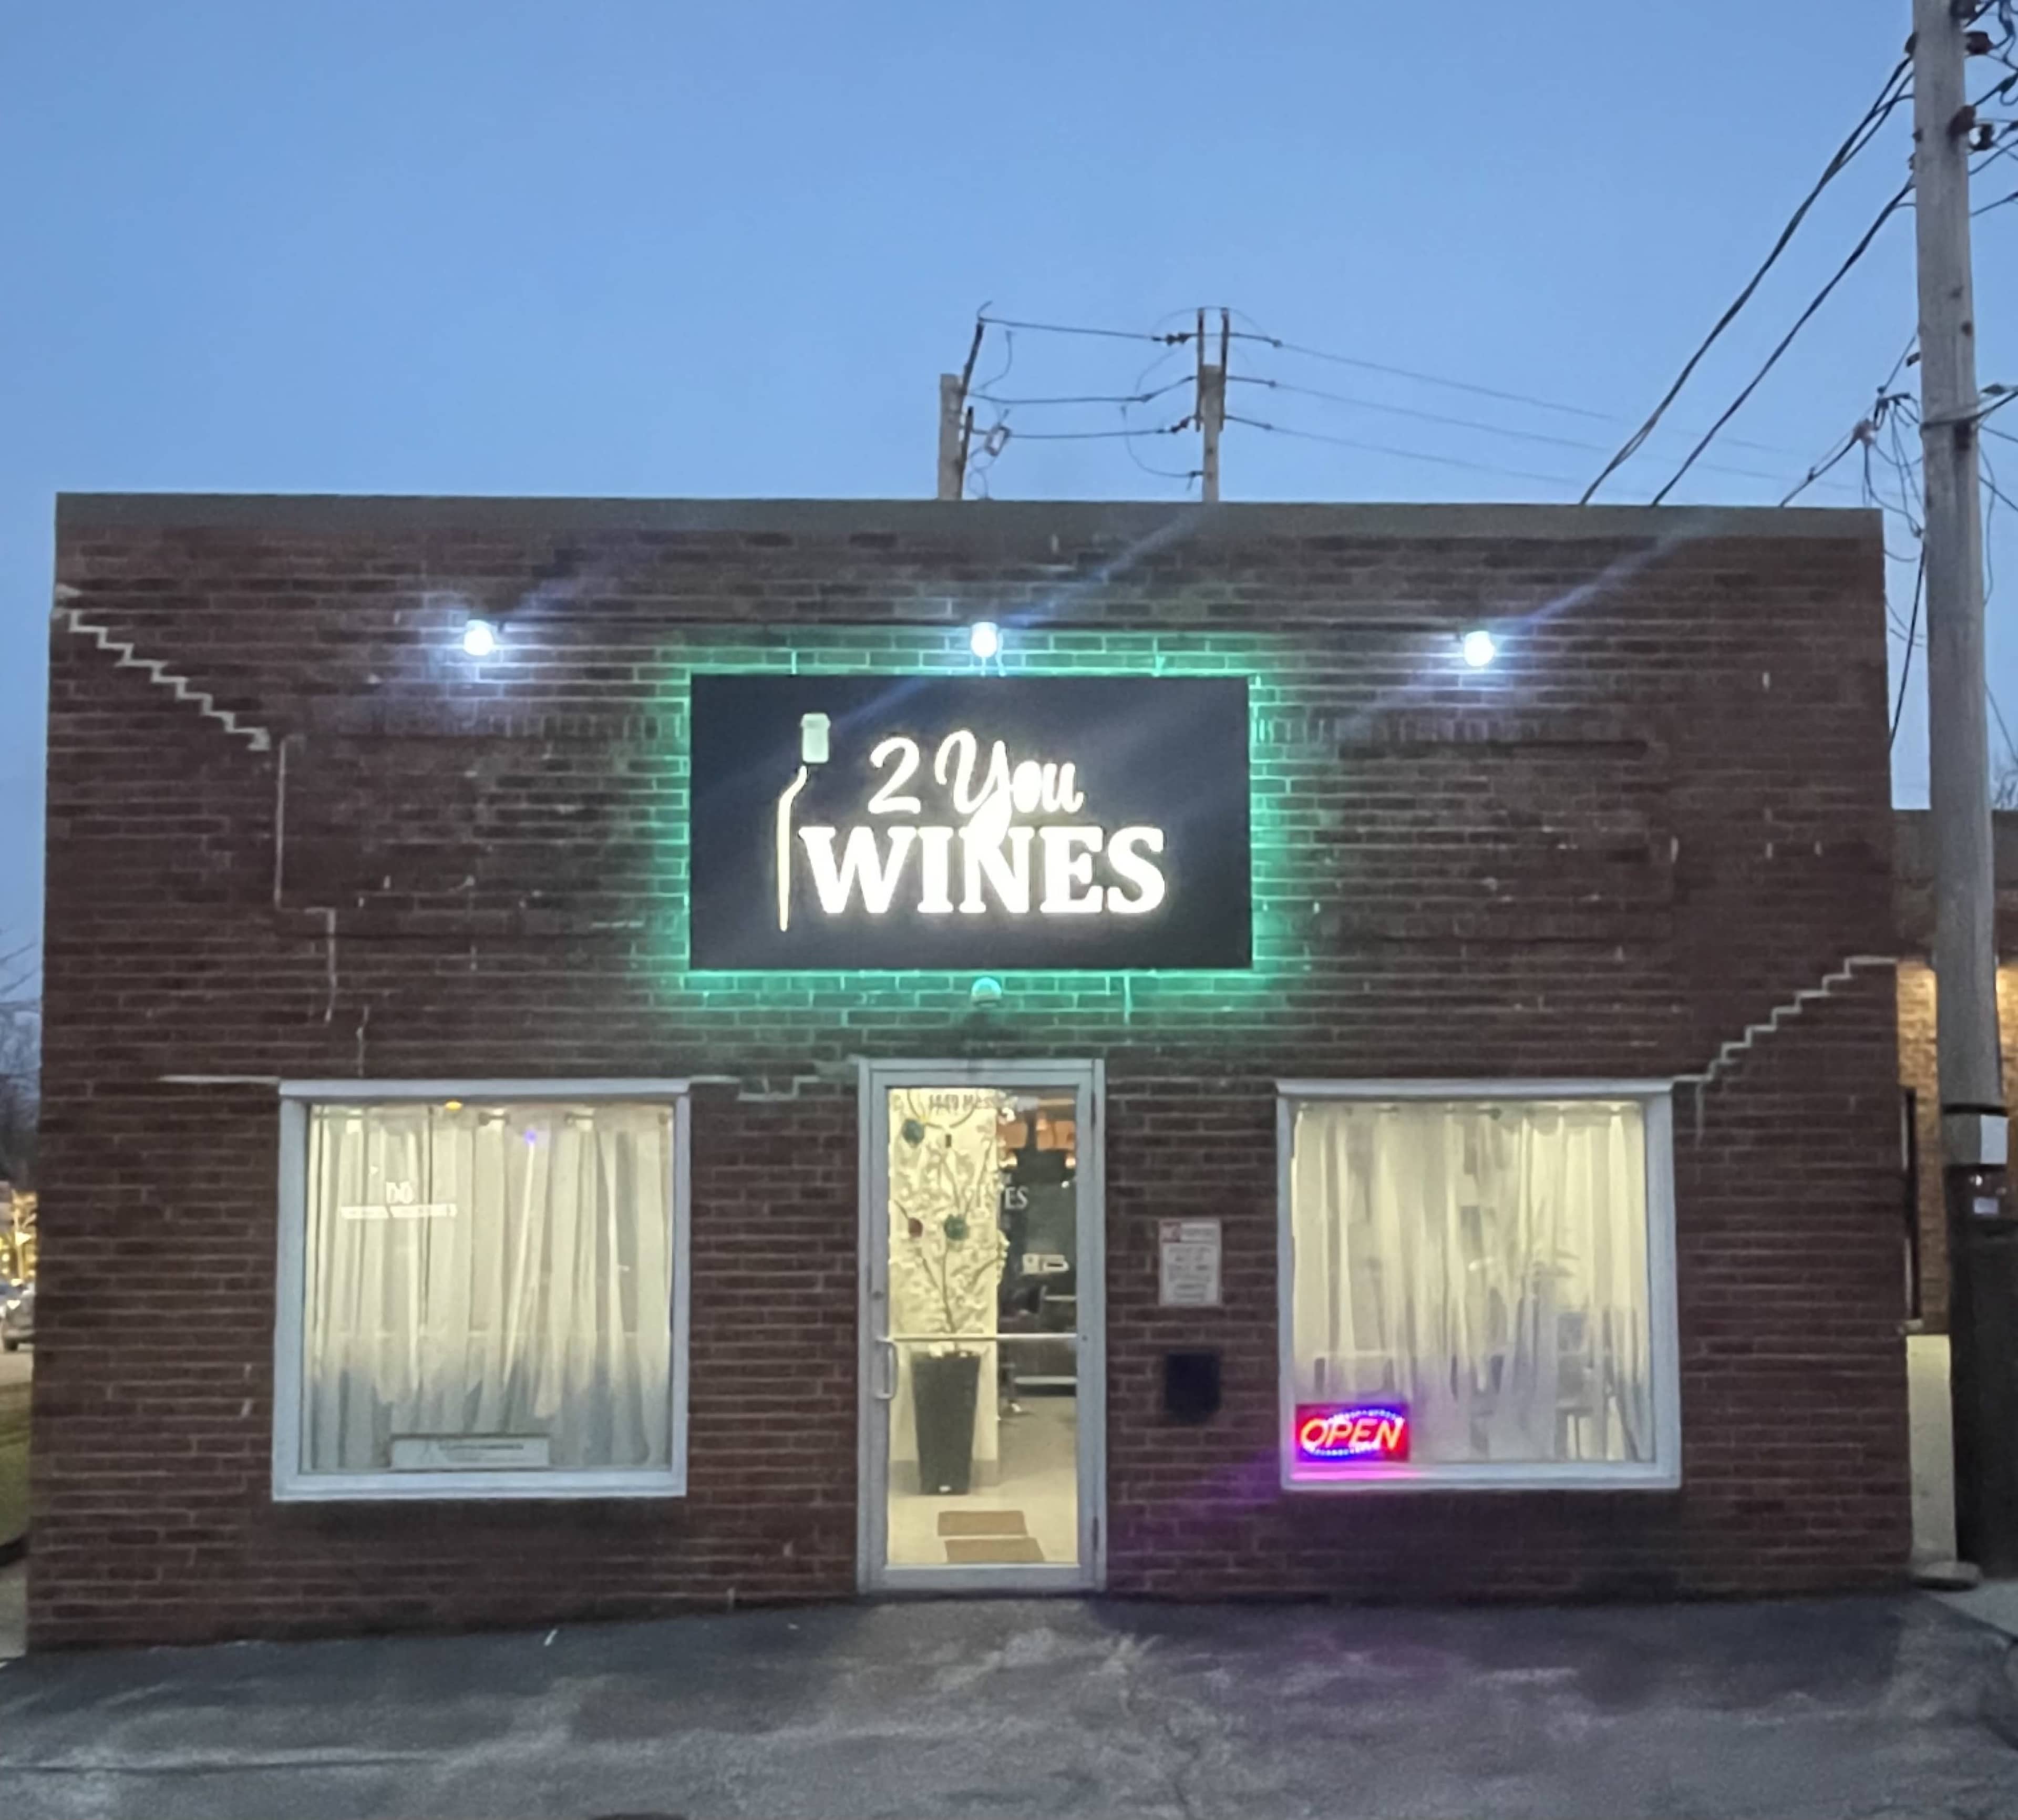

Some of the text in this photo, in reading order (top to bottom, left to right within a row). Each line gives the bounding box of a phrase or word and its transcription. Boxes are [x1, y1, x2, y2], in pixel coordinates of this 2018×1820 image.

[868, 730, 1084, 838] 2 You
[798, 826, 1165, 914] WINES
[1301, 1417, 1404, 1449] OPEN
